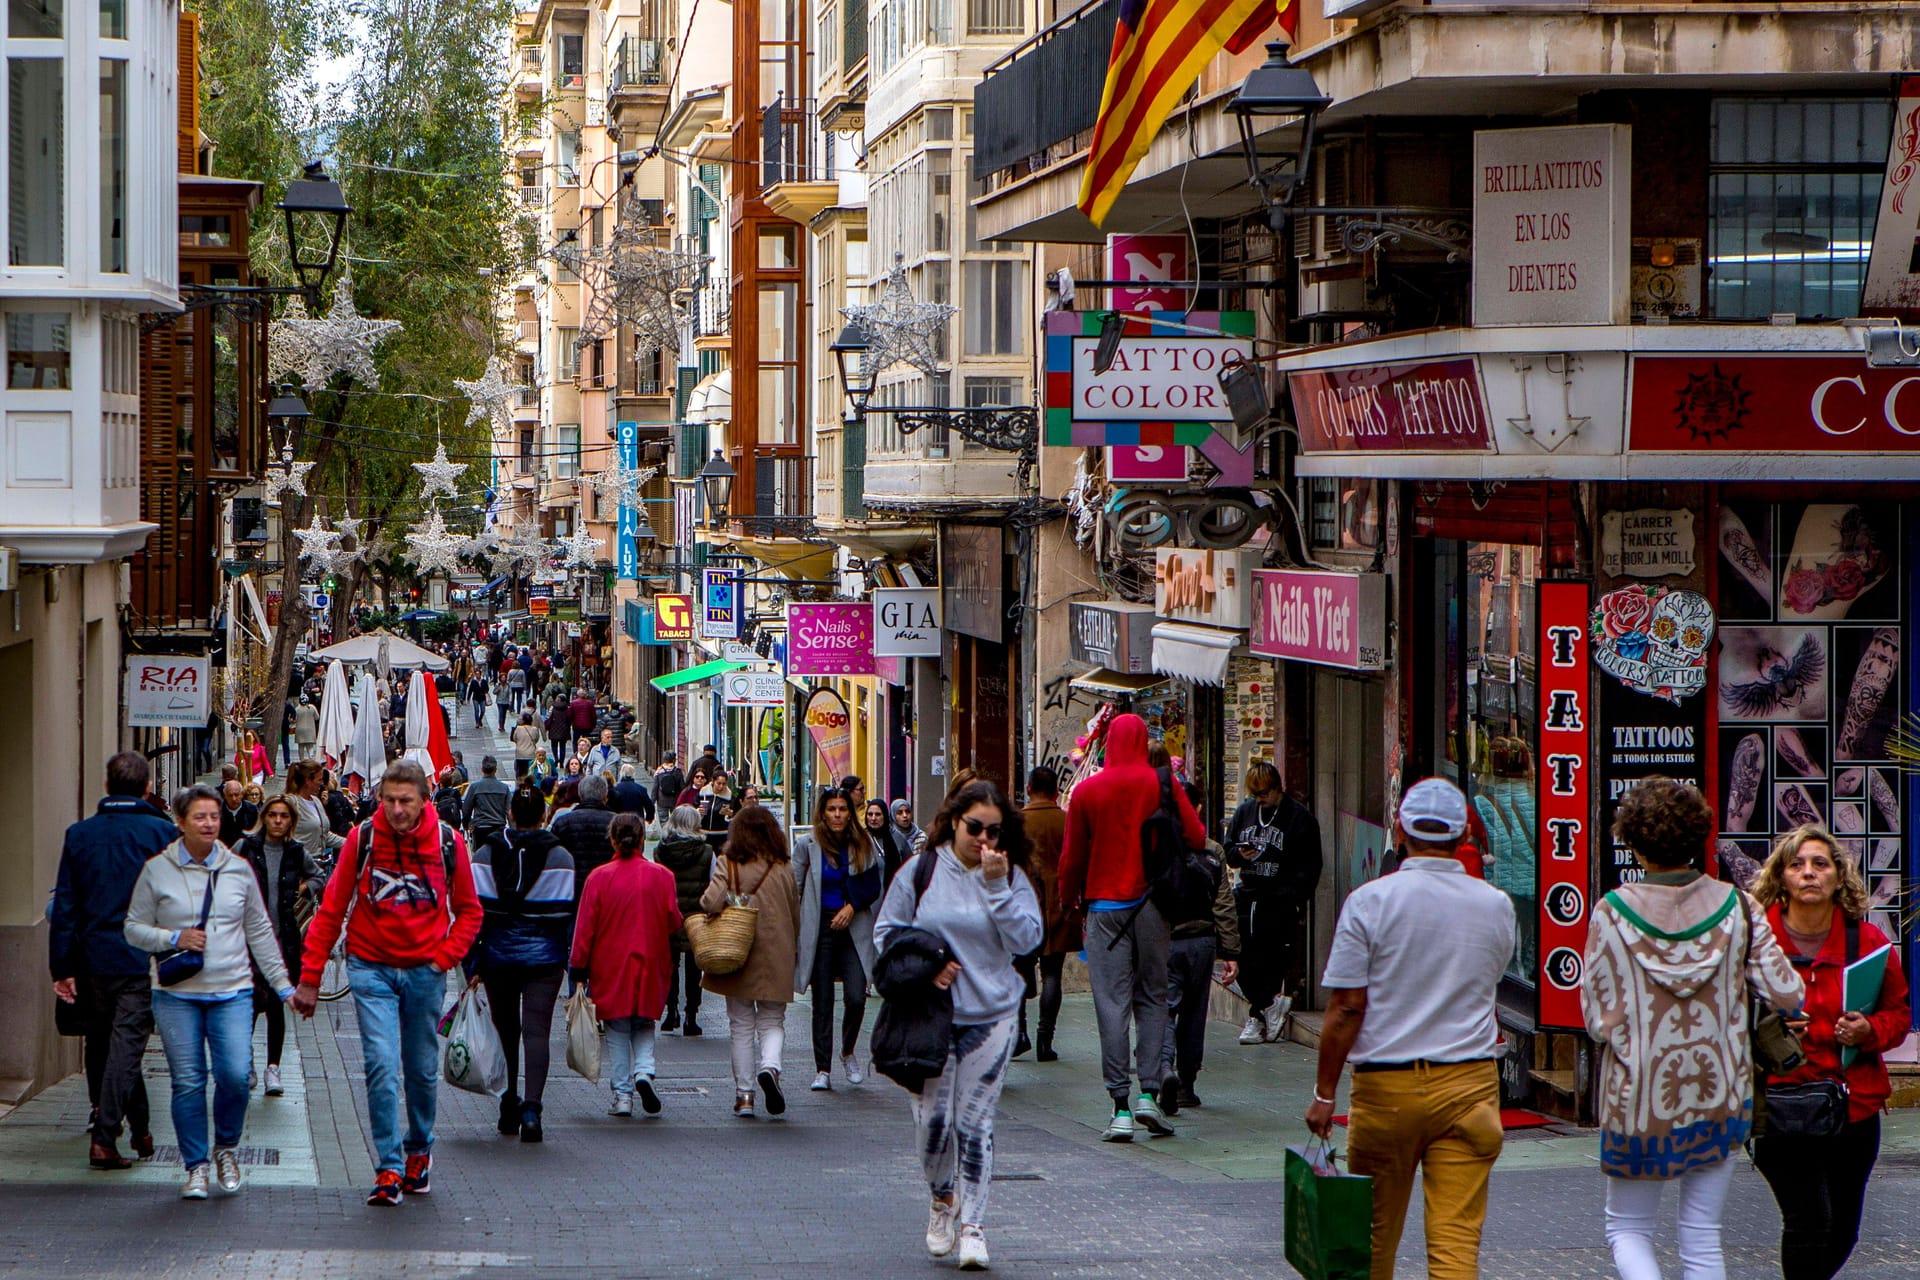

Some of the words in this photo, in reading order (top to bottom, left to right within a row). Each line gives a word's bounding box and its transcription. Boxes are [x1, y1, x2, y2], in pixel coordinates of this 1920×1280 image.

[1484, 160, 1602, 193] BRILLANTITOS
[1515, 213, 1536, 242] EN
[1541, 212, 1571, 241] LOS
[1508, 263, 1577, 292] DIENTES
[1084, 384, 1230, 409] COLOR
[1317, 383, 1388, 440] COLORS
[1393, 377, 1477, 435] TATTOO
[1624, 516, 1673, 529] CARRER
[1621, 532, 1678, 547] FRANCESC
[1622, 552, 1658, 565] BORJA
[1661, 550, 1691, 564] MOLL
[708, 609, 731, 620] TIN
[881, 602, 939, 629] GIA
[1269, 582, 1309, 648] Nails
[1313, 587, 1351, 653] Viet
[658, 630, 690, 638] TABACS
[815, 618, 852, 634] Nails
[894, 630, 928, 641] mia
[796, 626, 858, 649] Sense
[1597, 647, 1647, 683] COLORS
[1656, 669, 1703, 684] TATTOO
[140, 667, 197, 686] RIA
[140, 684, 198, 692] Menorca
[1613, 726, 1695, 749] TATTOOS
[1613, 754, 1622, 764] DE
[1625, 754, 1649, 764] TODOS
[1650, 754, 1664, 764] LOS
[1666, 754, 1695, 764] ESTILOS
[1544, 625, 1584, 990] TATTOO
[1614, 849, 1633, 865] DE
